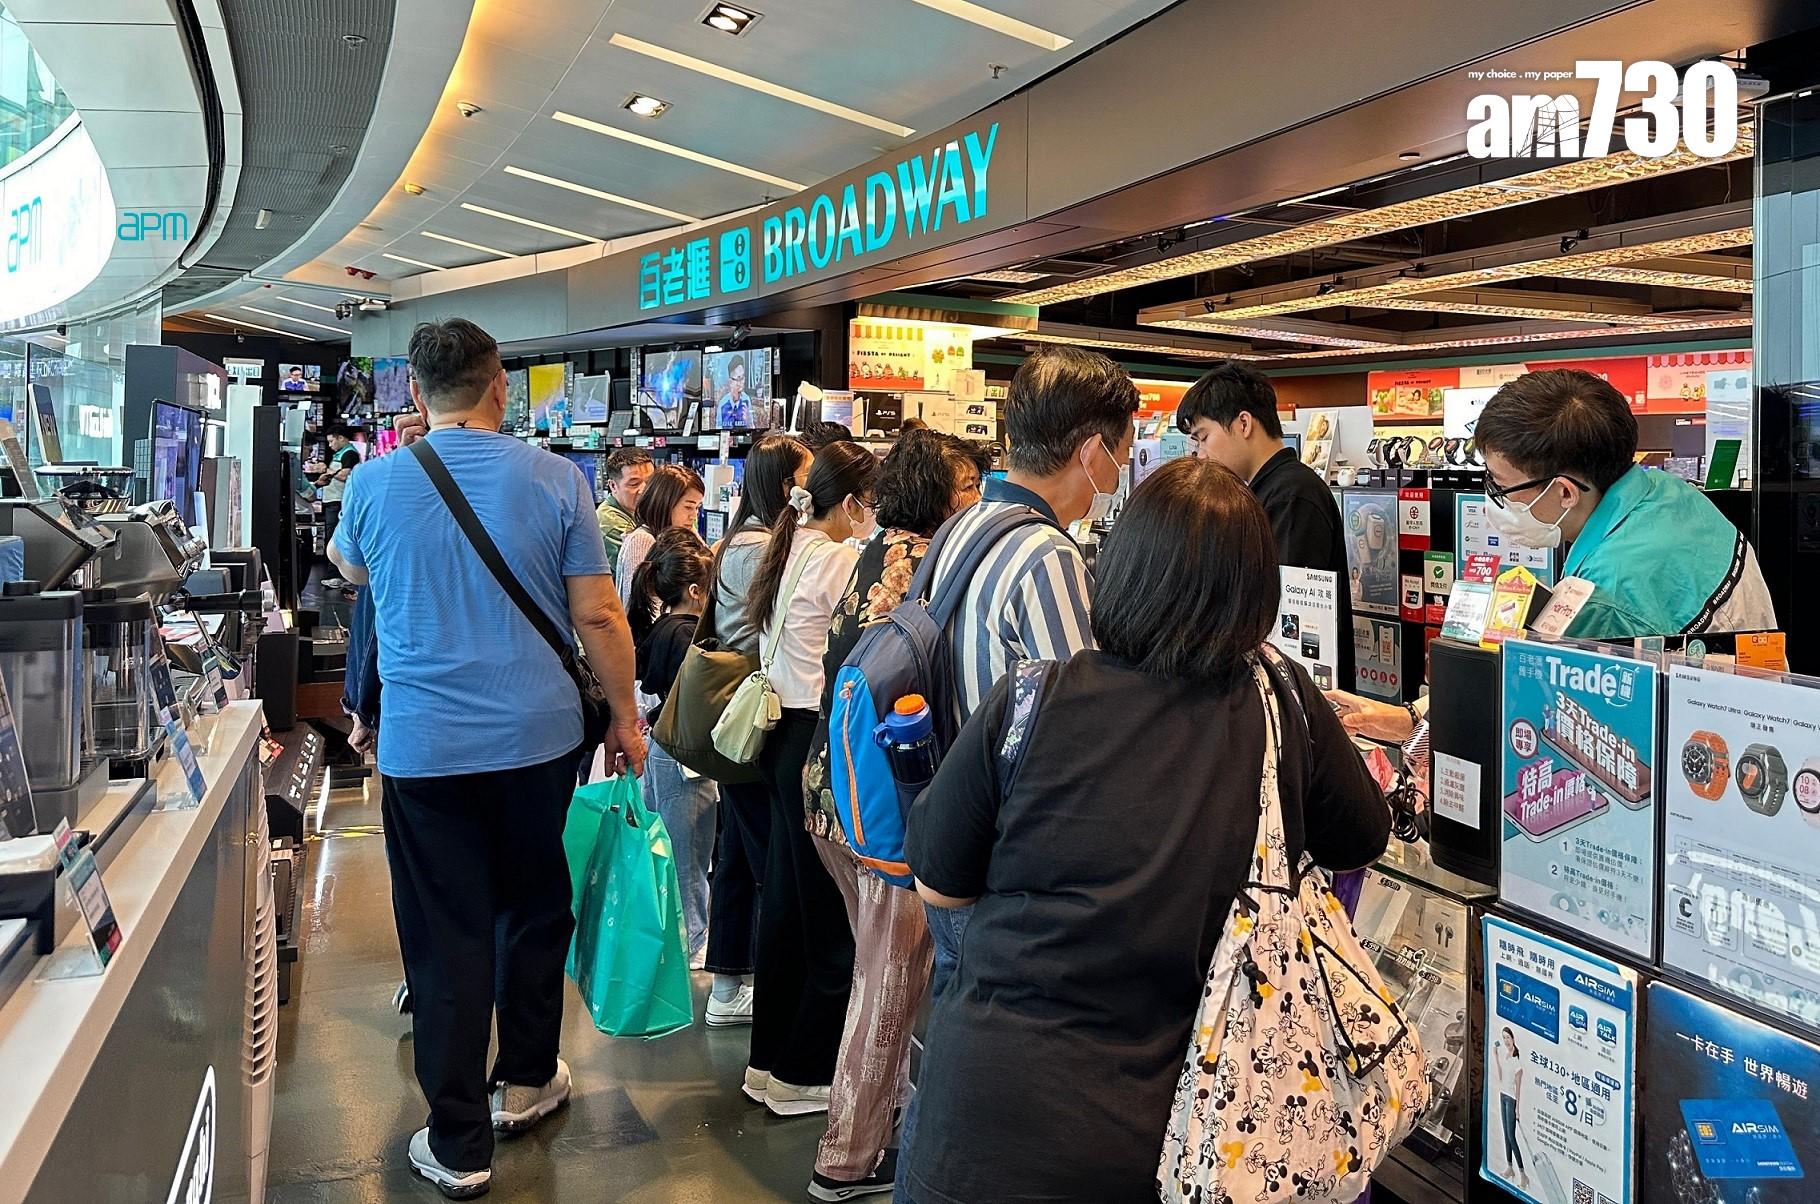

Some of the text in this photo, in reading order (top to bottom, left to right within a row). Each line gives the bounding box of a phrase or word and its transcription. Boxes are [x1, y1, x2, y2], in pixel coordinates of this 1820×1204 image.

[764, 122, 999, 285] BROADWAY
[117, 212, 188, 241] apm
[8, 196, 42, 272] apm
[1306, 573, 1333, 583] SAMSUNG
[1476, 566, 1492, 577] 700
[1285, 584, 1308, 598] Galaxy
[1712, 580, 1732, 605] BROADWAY
[1545, 655, 1617, 698] Trade
[1675, 672, 1701, 682] SAMSUNG
[1687, 698, 1707, 709] Galaxy
[1728, 706, 1741, 714] Ultra
[1743, 709, 1766, 721] Galaxy
[1766, 713, 1790, 724] Watch7
[1793, 719, 1817, 731] Galaxy
[1556, 708, 1637, 790] 價格保障
[1800, 775, 1810, 785] 10
[1799, 785, 1810, 795] 08
[1563, 841, 1568, 851] 1
[1551, 864, 1558, 875] 2
[1499, 938, 1556, 970] 隨時飛 隨時用
[1574, 973, 1616, 998] AIRSIM
[1523, 992, 1556, 1012] AIRSIM
[1570, 1011, 1585, 1021] AIR
[1598, 1023, 1612, 1034] AIR
[1600, 1031, 1616, 1042] TALK
[1675, 1032, 1808, 1100] 一卡在手 世界暢遊
[1731, 1122, 1780, 1134] AIRSIM
